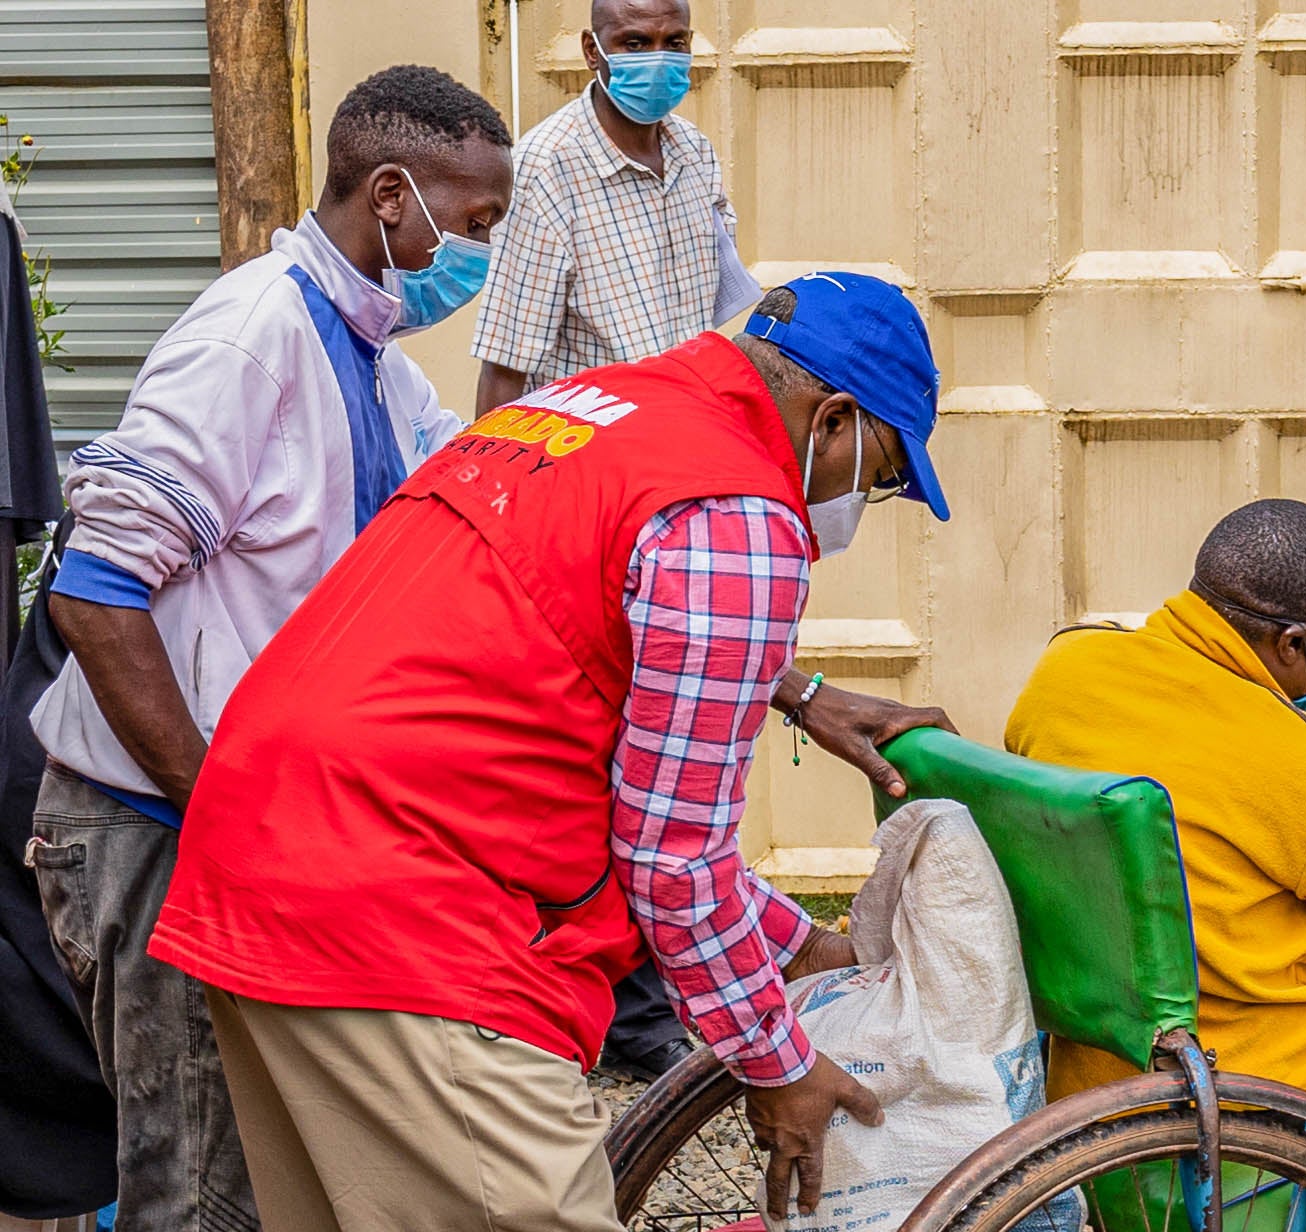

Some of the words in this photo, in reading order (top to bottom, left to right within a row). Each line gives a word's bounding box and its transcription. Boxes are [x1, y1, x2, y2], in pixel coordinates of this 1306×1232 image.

[512, 382, 639, 427] AMA
[447, 437, 554, 475] ARITY
[844, 1061, 885, 1074] ation
